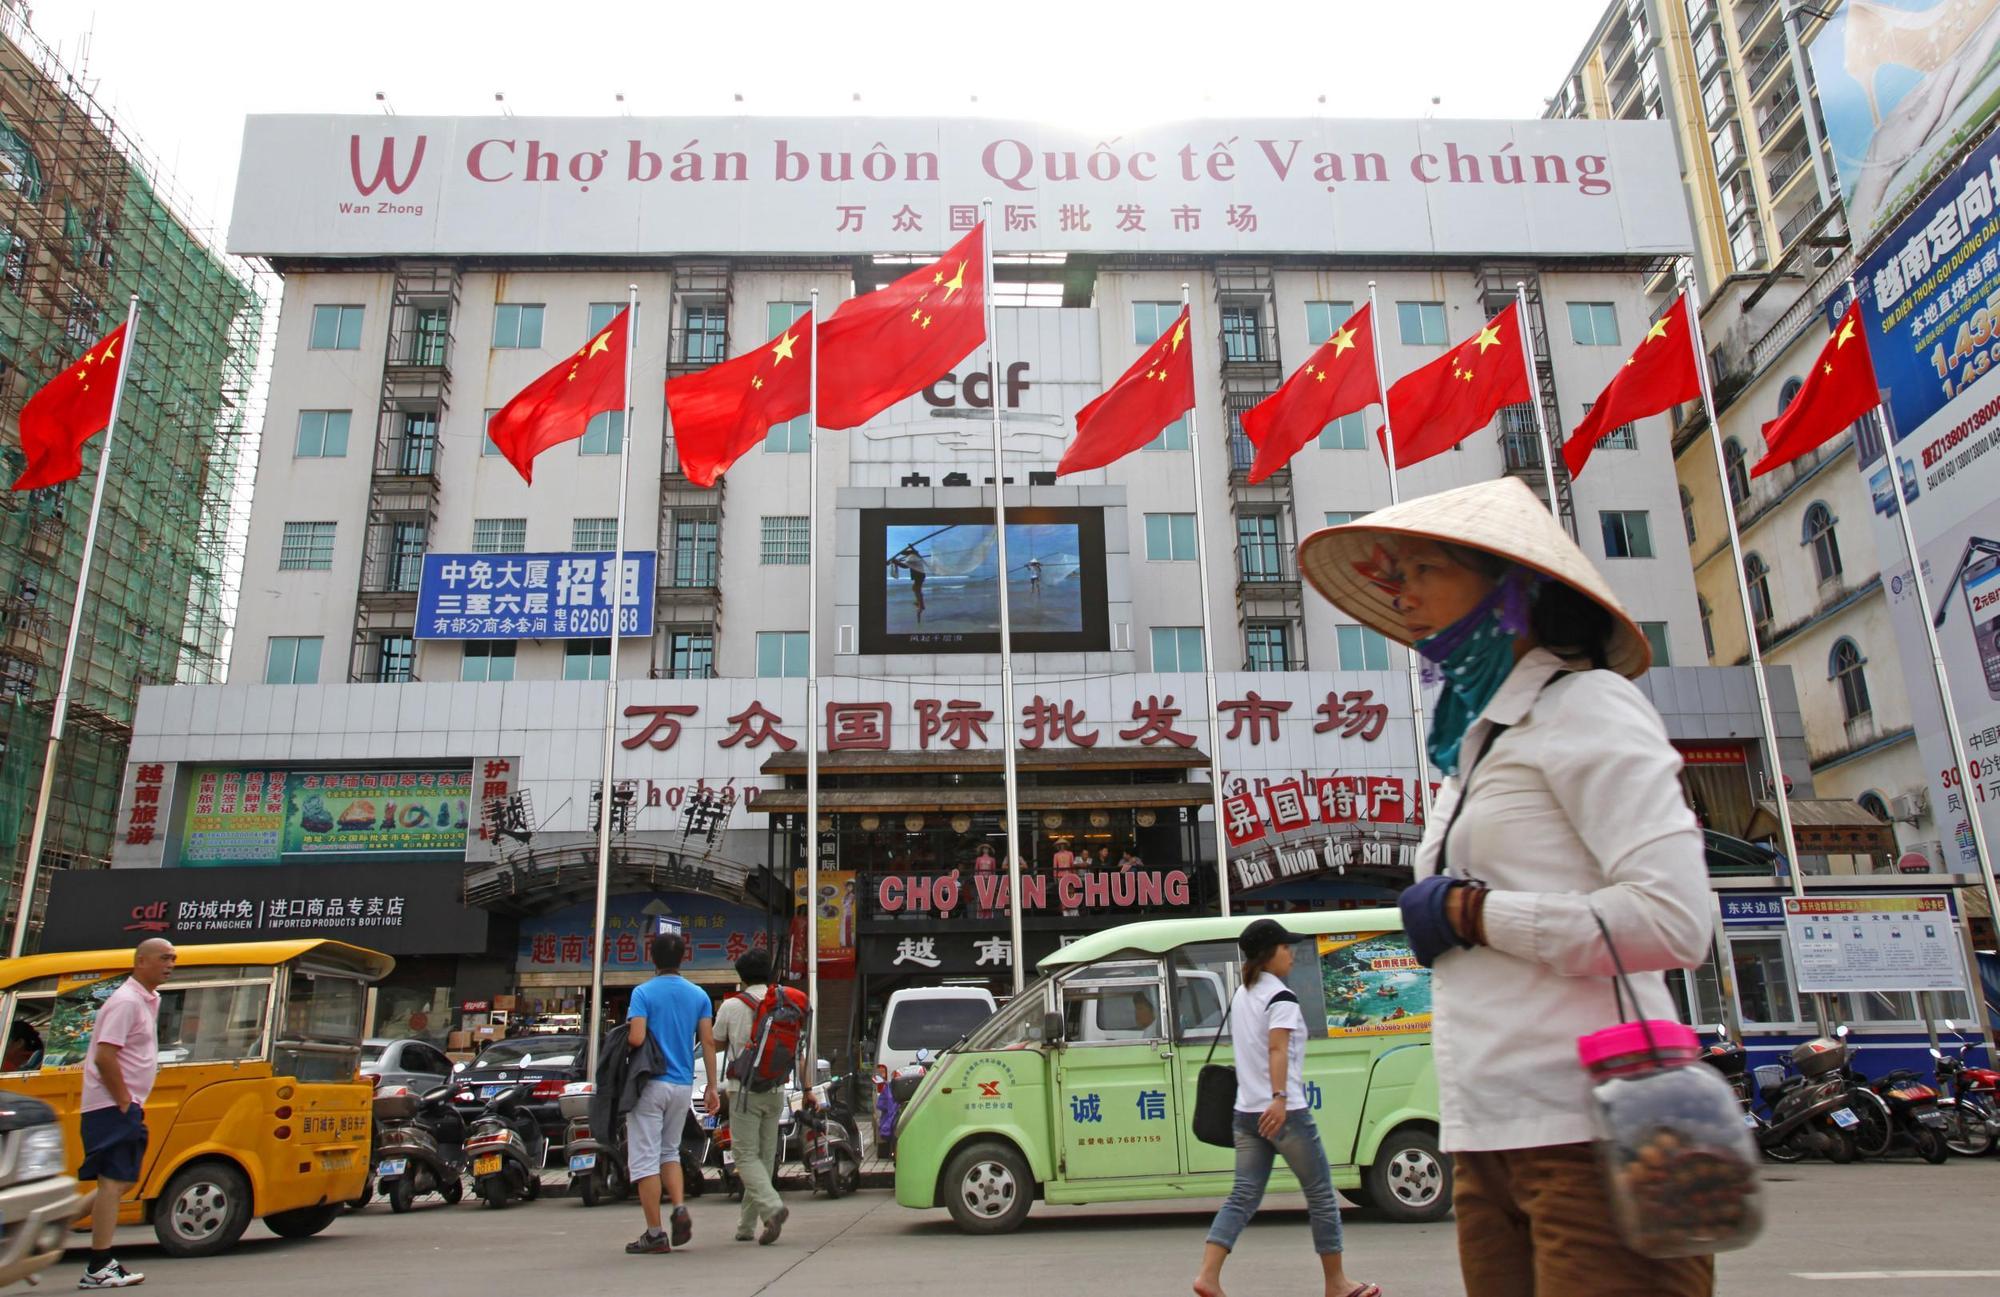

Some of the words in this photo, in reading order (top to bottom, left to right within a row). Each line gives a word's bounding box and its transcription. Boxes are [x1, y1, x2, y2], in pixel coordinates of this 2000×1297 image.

[466, 139, 609, 193] Chợ
[627, 137, 750, 182] bán
[774, 139, 940, 183] buôn
[981, 136, 1158, 191] Quốc
[1178, 136, 1239, 182] tế
[1255, 138, 1390, 193] Vạn
[1410, 140, 1613, 196] chúng
[339, 202, 372, 215] Wan
[377, 201, 424, 217] Zhong
[836, 204, 1259, 233] 万众国际批发市场
[1911, 241, 2000, 337] 本地直拨越南
[922, 361, 1031, 409] cdf
[441, 560, 550, 590] 中免大厦
[556, 559, 641, 606] 招租
[436, 593, 549, 615] 三至六层
[433, 617, 548, 635] 有部分商务套间
[553, 608, 568, 633] 电话
[571, 607, 639, 633] 626088
[621, 690, 1389, 752] 万众国际批发市场
[127, 763, 165, 846] 越南旅游
[879, 868, 961, 919] CHỢ
[1058, 869, 1190, 907] CHUNG
[1727, 901, 1782, 915] 东兴边防
[131, 901, 170, 920] cdf
[177, 920, 203, 930] CDFG
[204, 919, 253, 930] FANGCHEN
[268, 918, 312, 929] IMPORTED
[312, 917, 356, 928] PRODUCTS
[358, 916, 402, 927] BOUTIQUE
[178, 901, 253, 920] 防城中免
[268, 897, 405, 918] 进口商品专卖店
[1069, 1089, 1167, 1123] 诚信
